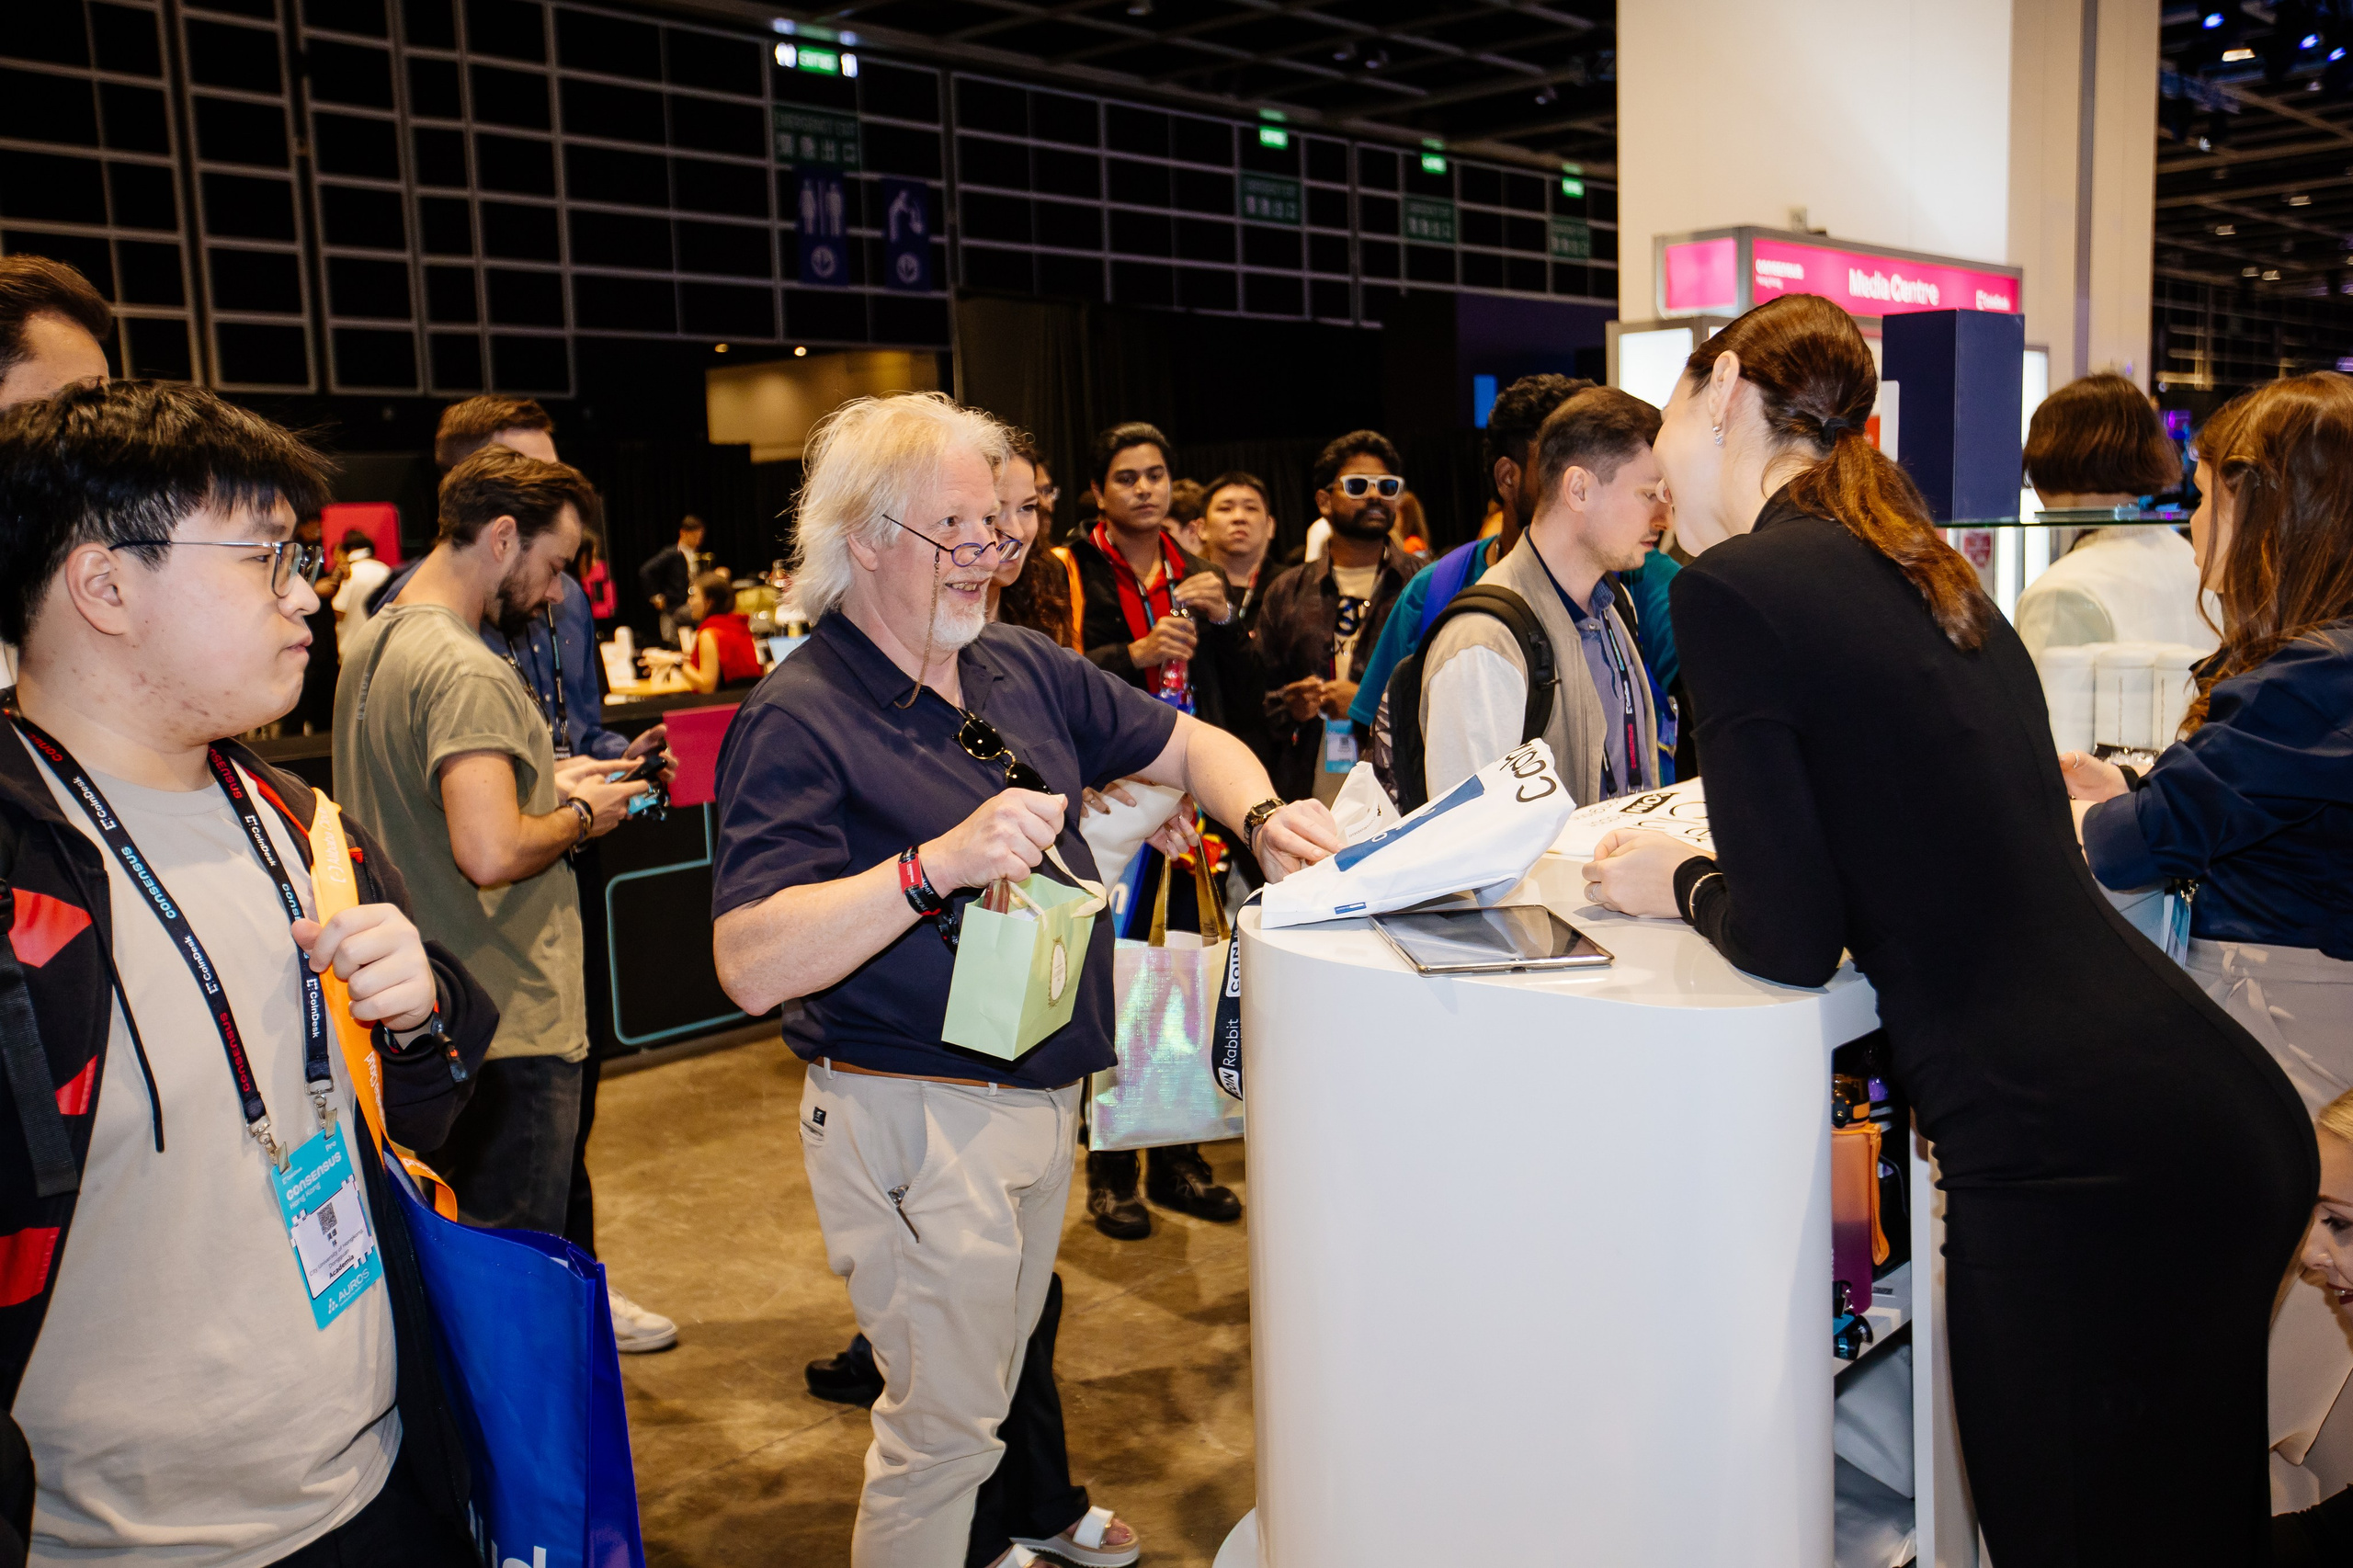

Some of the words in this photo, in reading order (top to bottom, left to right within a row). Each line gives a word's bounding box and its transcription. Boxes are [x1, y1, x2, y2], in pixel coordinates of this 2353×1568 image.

[1848, 267, 1892, 301] Media
[1890, 273, 1939, 306] Centre
[73, 775, 108, 819] CoinDesk
[251, 826, 277, 867] CoinDesk
[184, 935, 212, 982] CoinDesk
[309, 993, 321, 1039] CoinDesk
[1222, 1018, 1239, 1067] Rabbit
[325, 1141, 336, 1152] Pro
[286, 1151, 342, 1201] CONSENSUS
[290, 1194, 306, 1210] Hong
[305, 1182, 322, 1198] Kong
[317, 1251, 338, 1269] University
[328, 1248, 350, 1269] Dongguan
[329, 1255, 355, 1279] Academia
[338, 1267, 369, 1302] AUROS
